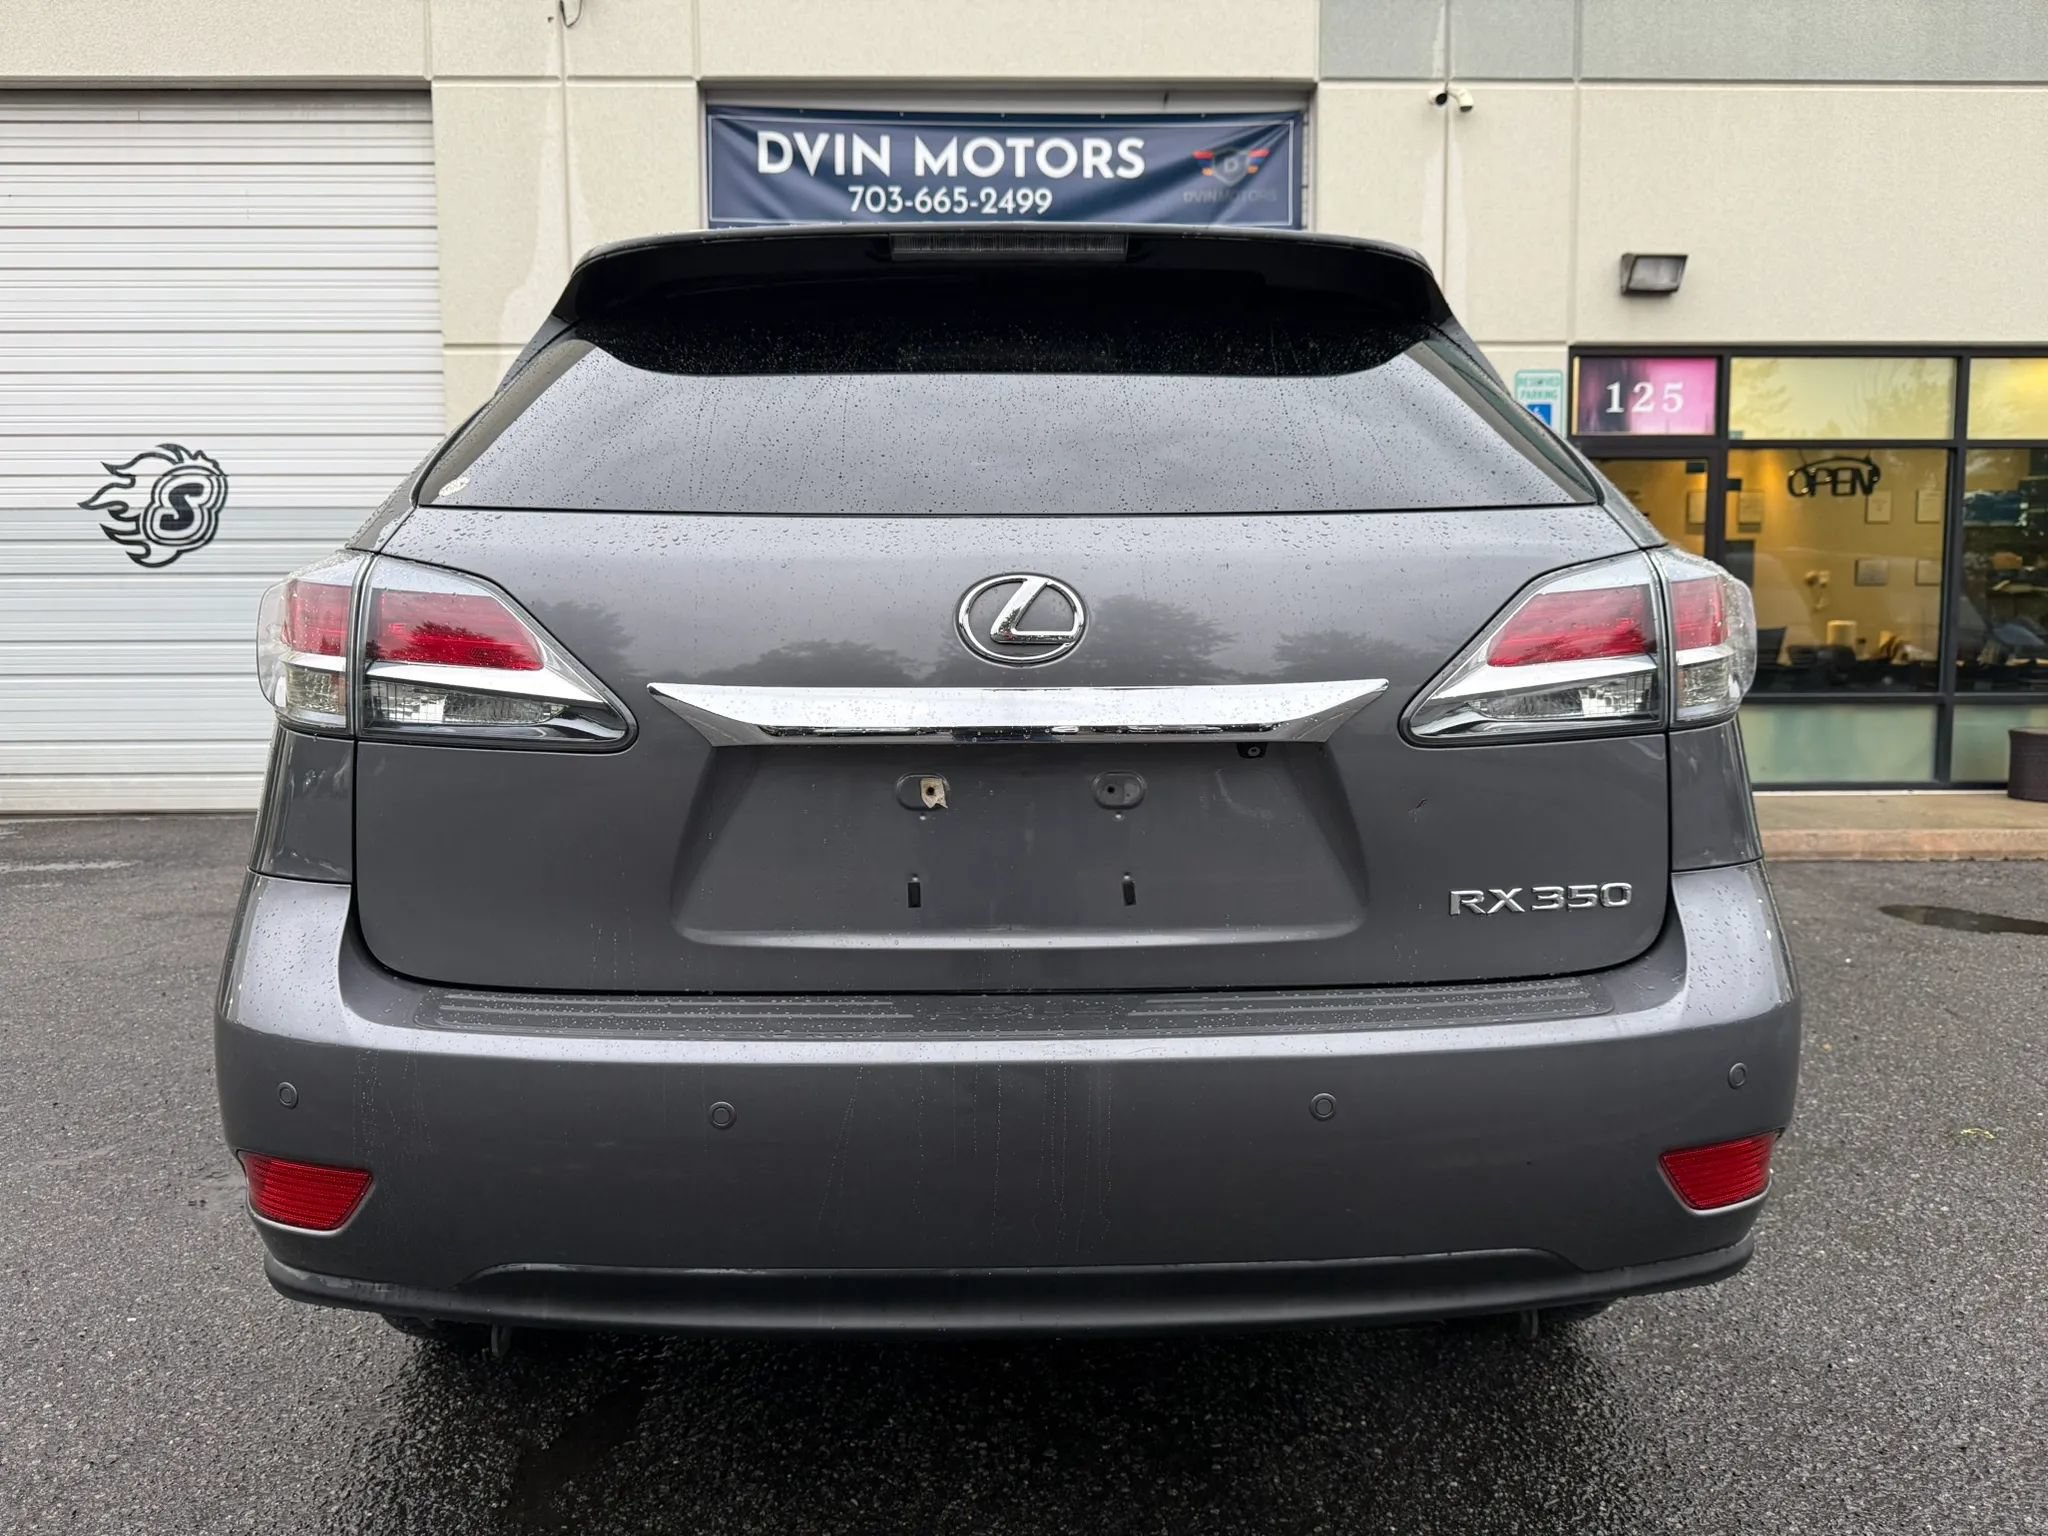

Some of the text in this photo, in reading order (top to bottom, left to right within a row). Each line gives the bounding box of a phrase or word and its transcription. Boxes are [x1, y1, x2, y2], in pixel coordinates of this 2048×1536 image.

[756, 131, 1146, 179] DVIN MOTORS
[847, 185, 1053, 215] 703-665-2499
[1605, 382, 1685, 413] 125
[1788, 464, 1875, 497] OPEN
[1449, 882, 1633, 916] RX 350
